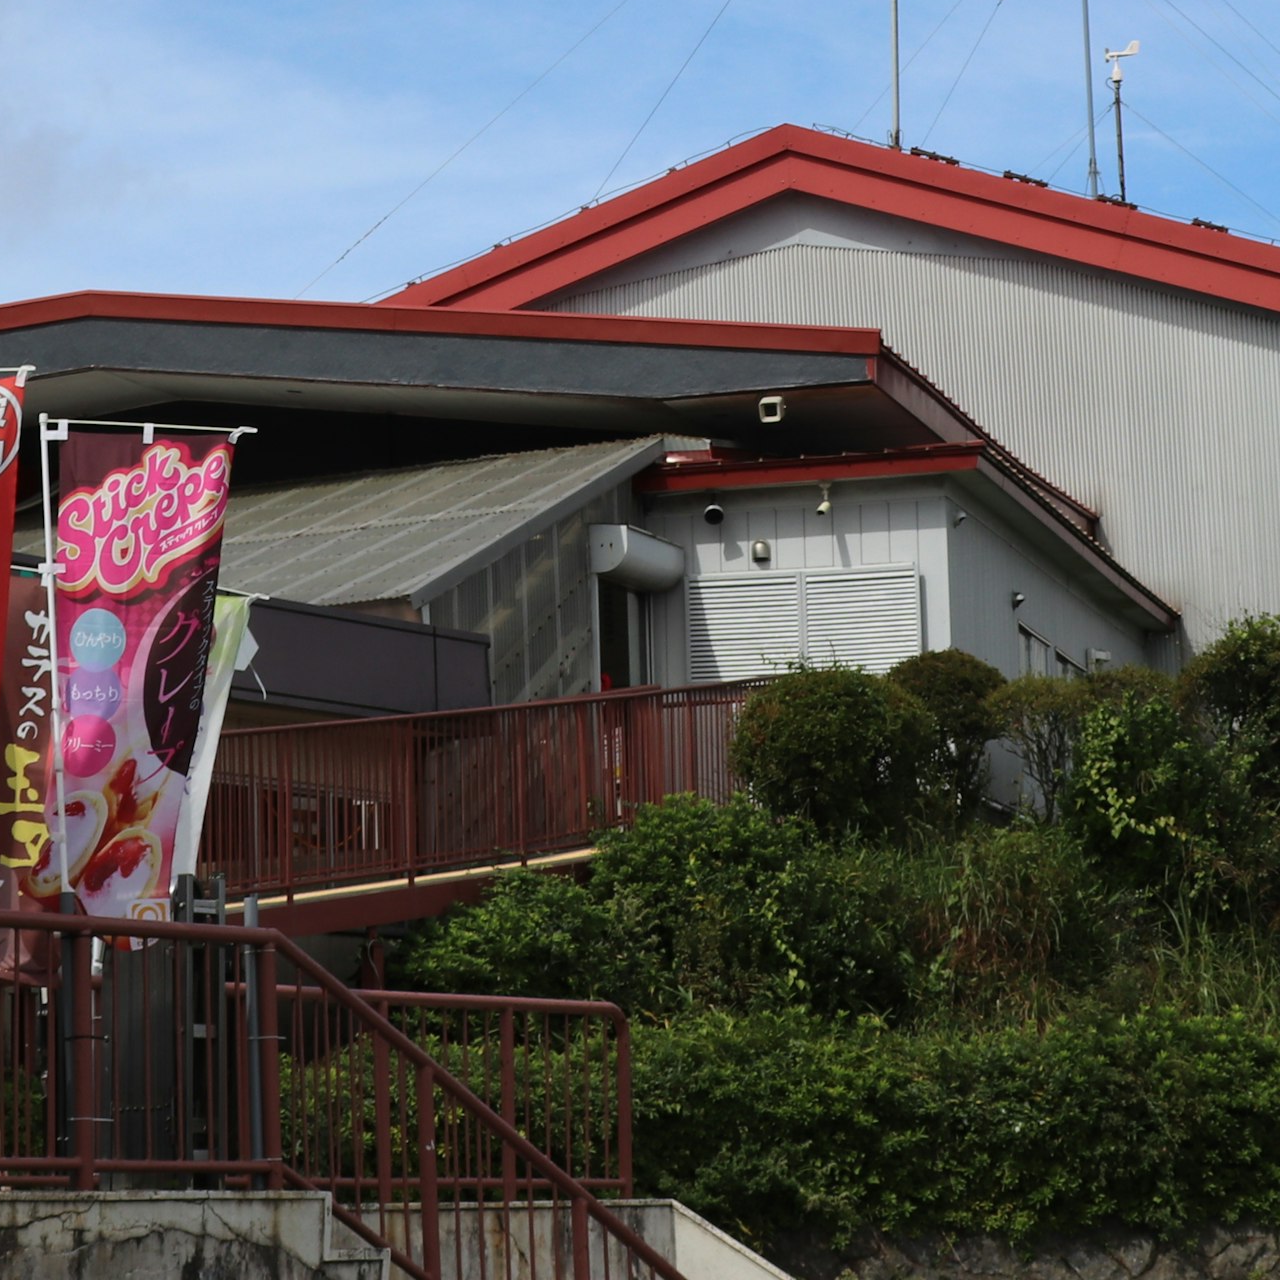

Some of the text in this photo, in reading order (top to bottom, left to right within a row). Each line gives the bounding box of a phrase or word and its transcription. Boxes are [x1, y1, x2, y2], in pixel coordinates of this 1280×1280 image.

[57, 450, 179, 584] Stick
[99, 454, 227, 585] Crepe
[71, 684, 118, 702] もっちり
[74, 631, 122, 648] ひんやり
[189, 581, 214, 711] スティックタイプの
